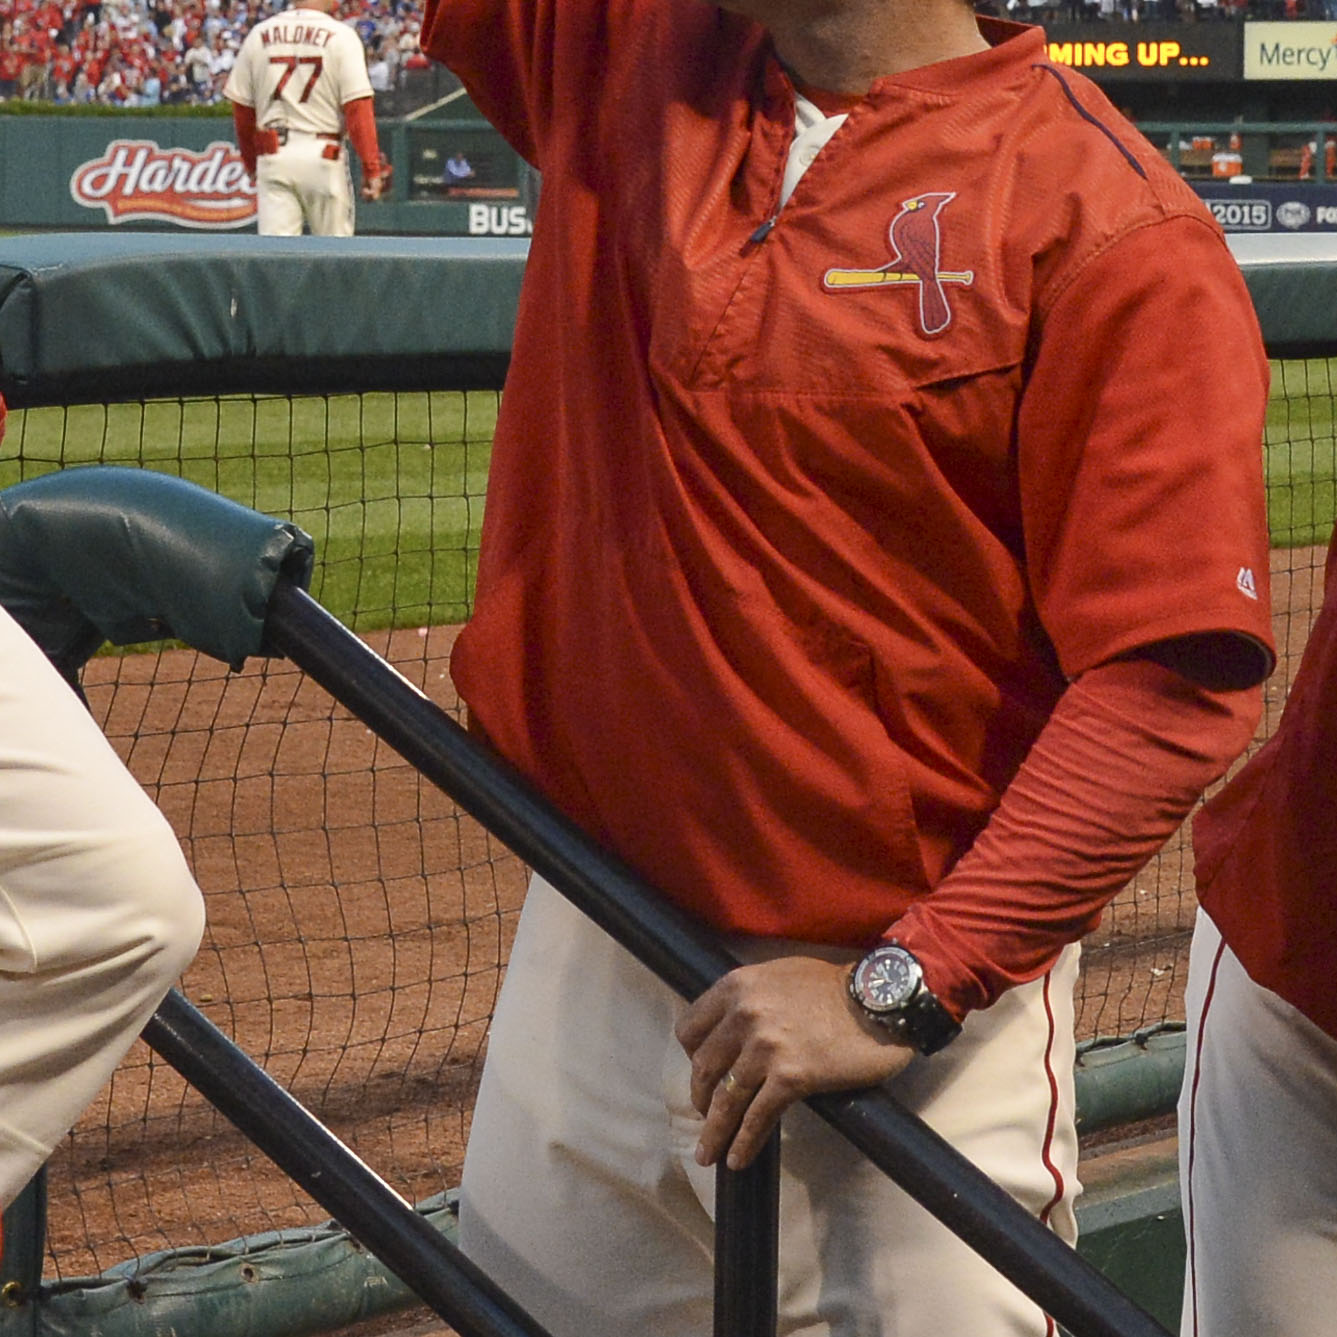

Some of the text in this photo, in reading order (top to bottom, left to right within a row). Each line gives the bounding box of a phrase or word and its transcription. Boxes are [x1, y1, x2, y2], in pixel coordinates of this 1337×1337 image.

[260, 25, 336, 48] MALONEY
[1048, 40, 1210, 67] MING UP...
[1259, 42, 1332, 72] Mercy
[268, 55, 323, 104] 77
[1213, 204, 1267, 225] 2015
